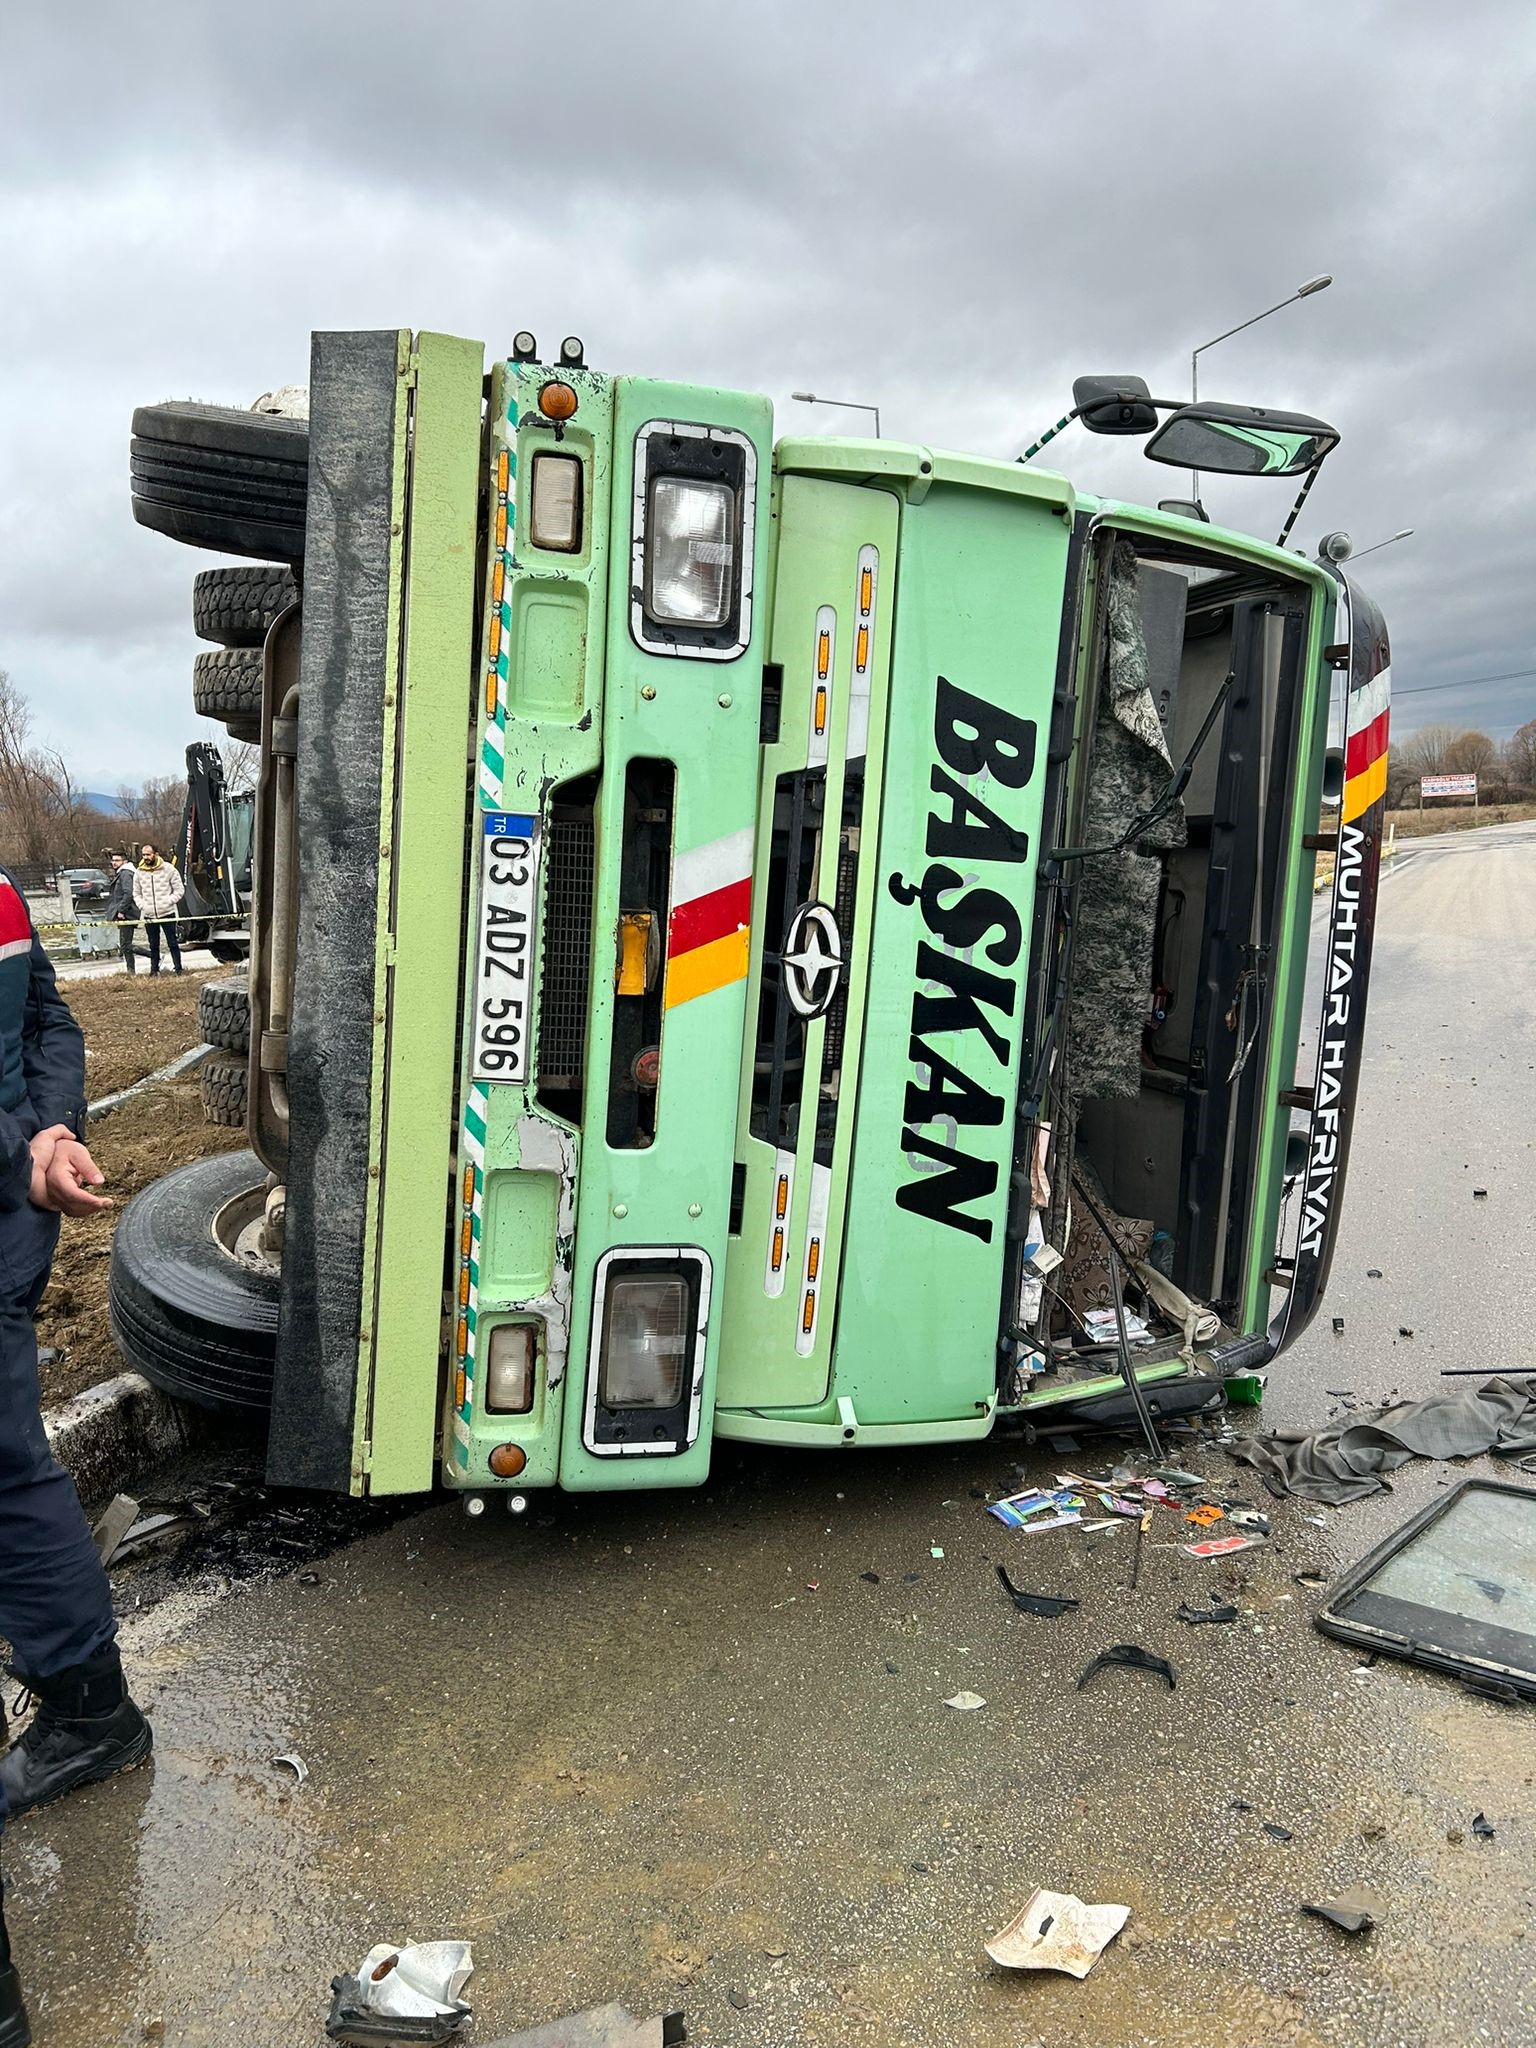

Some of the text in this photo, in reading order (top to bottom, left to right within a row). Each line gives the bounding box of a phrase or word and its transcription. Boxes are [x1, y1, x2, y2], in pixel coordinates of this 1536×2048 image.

[480, 838, 530, 1071] 03 ADZ 596
[494, 817, 507, 833] TR
[887, 675, 1038, 1245] BAŞKAN
[1300, 825, 1365, 1258] MUHTAR HAFRİYAT
